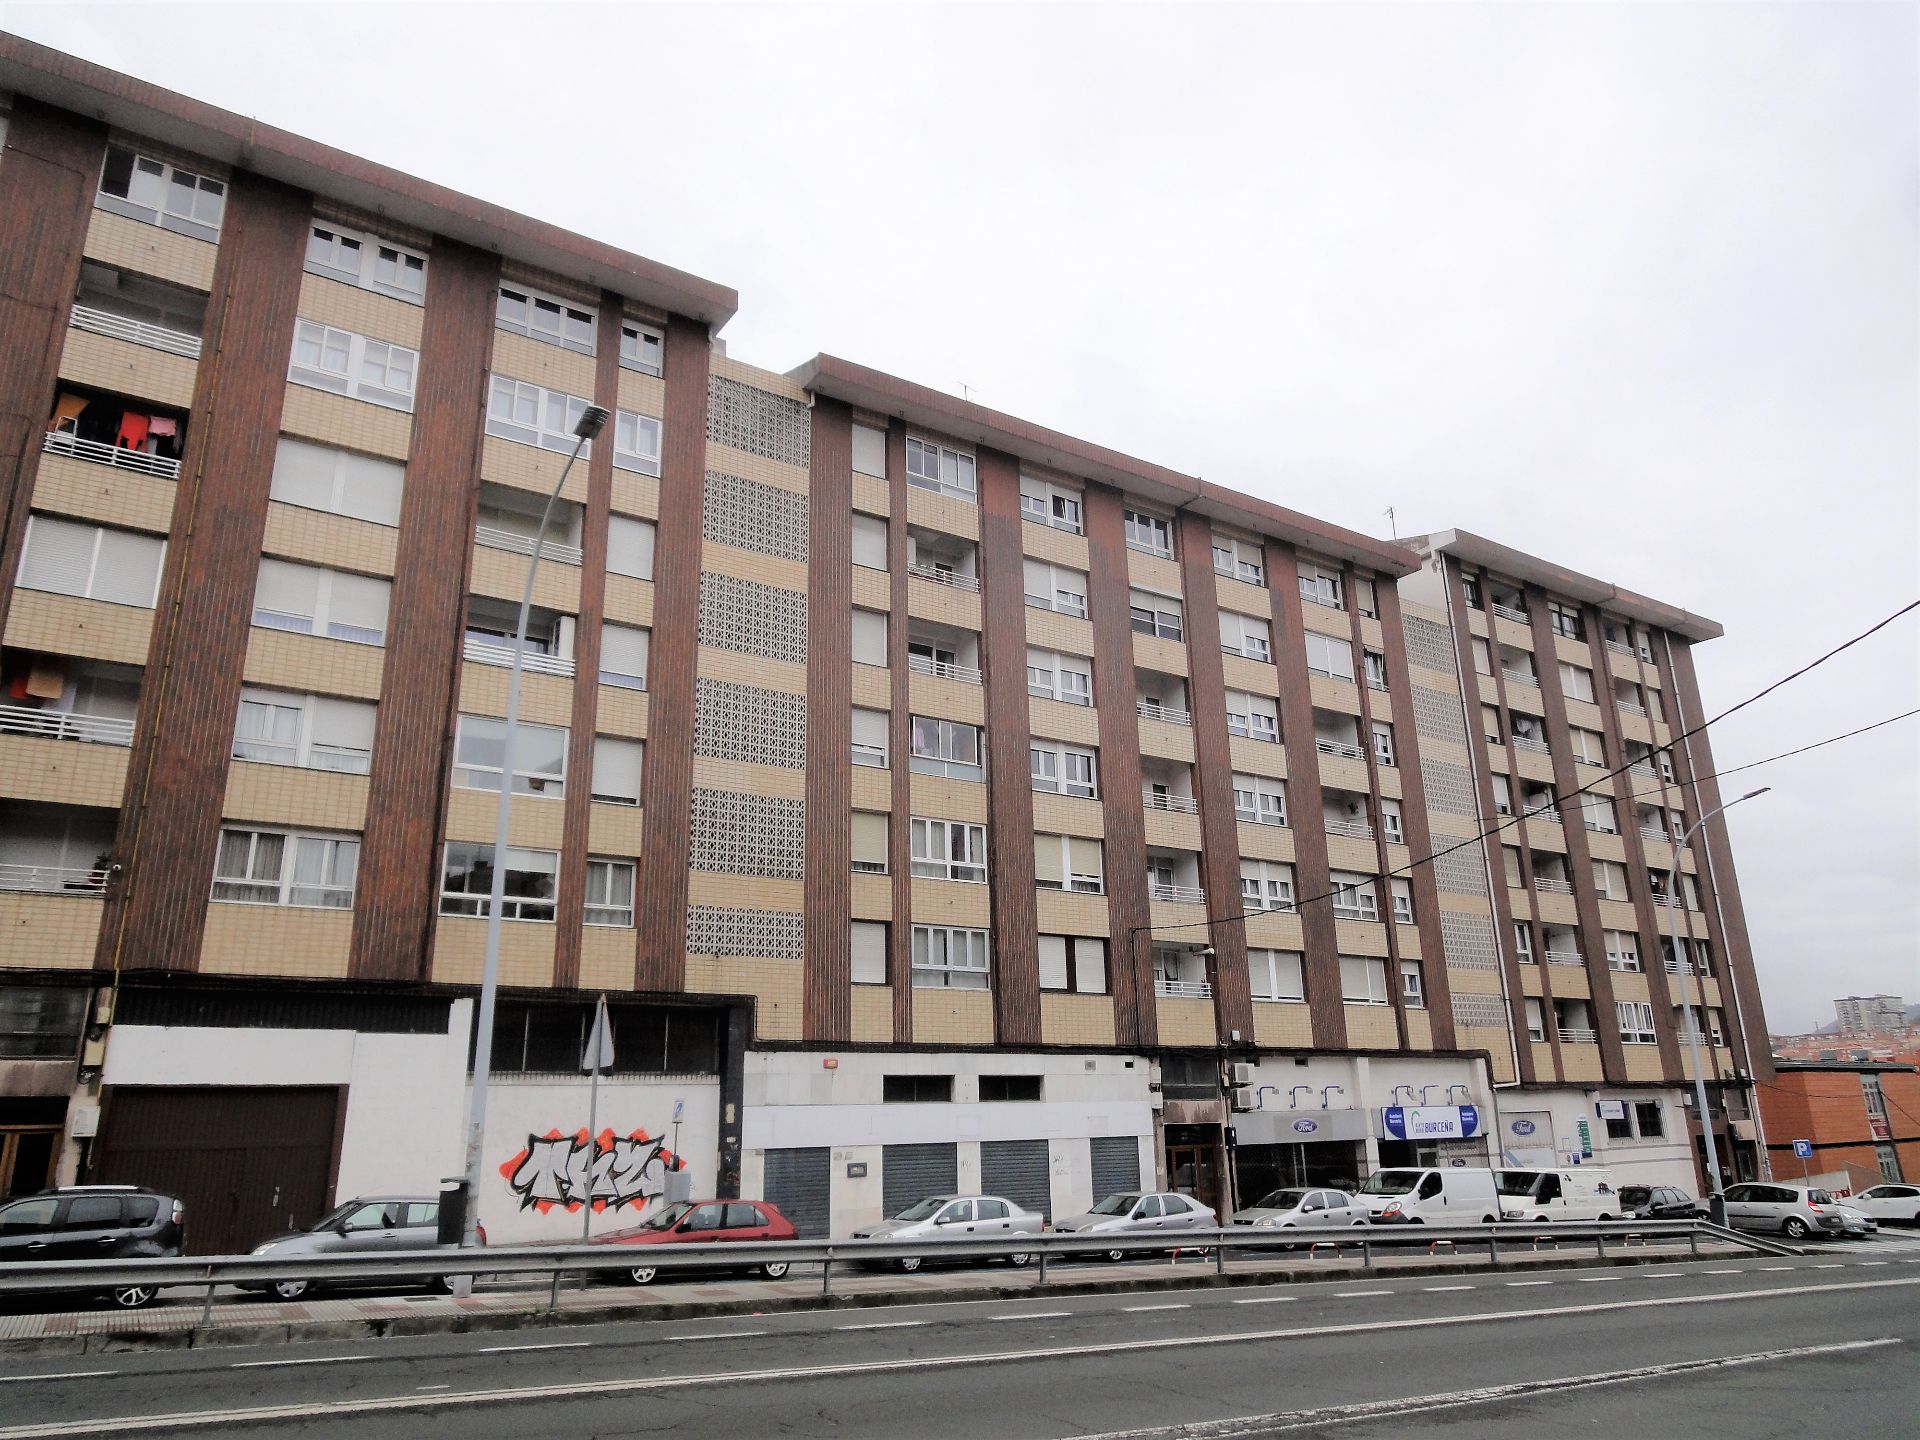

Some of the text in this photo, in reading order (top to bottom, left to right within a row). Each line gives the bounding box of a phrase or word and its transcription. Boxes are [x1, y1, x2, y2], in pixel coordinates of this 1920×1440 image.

[1297, 1121, 1314, 1132] Ford
[1424, 1119, 1454, 1133] BURCEÑA
[1516, 1121, 1532, 1133] Ford
[1796, 1142, 1807, 1156] P
